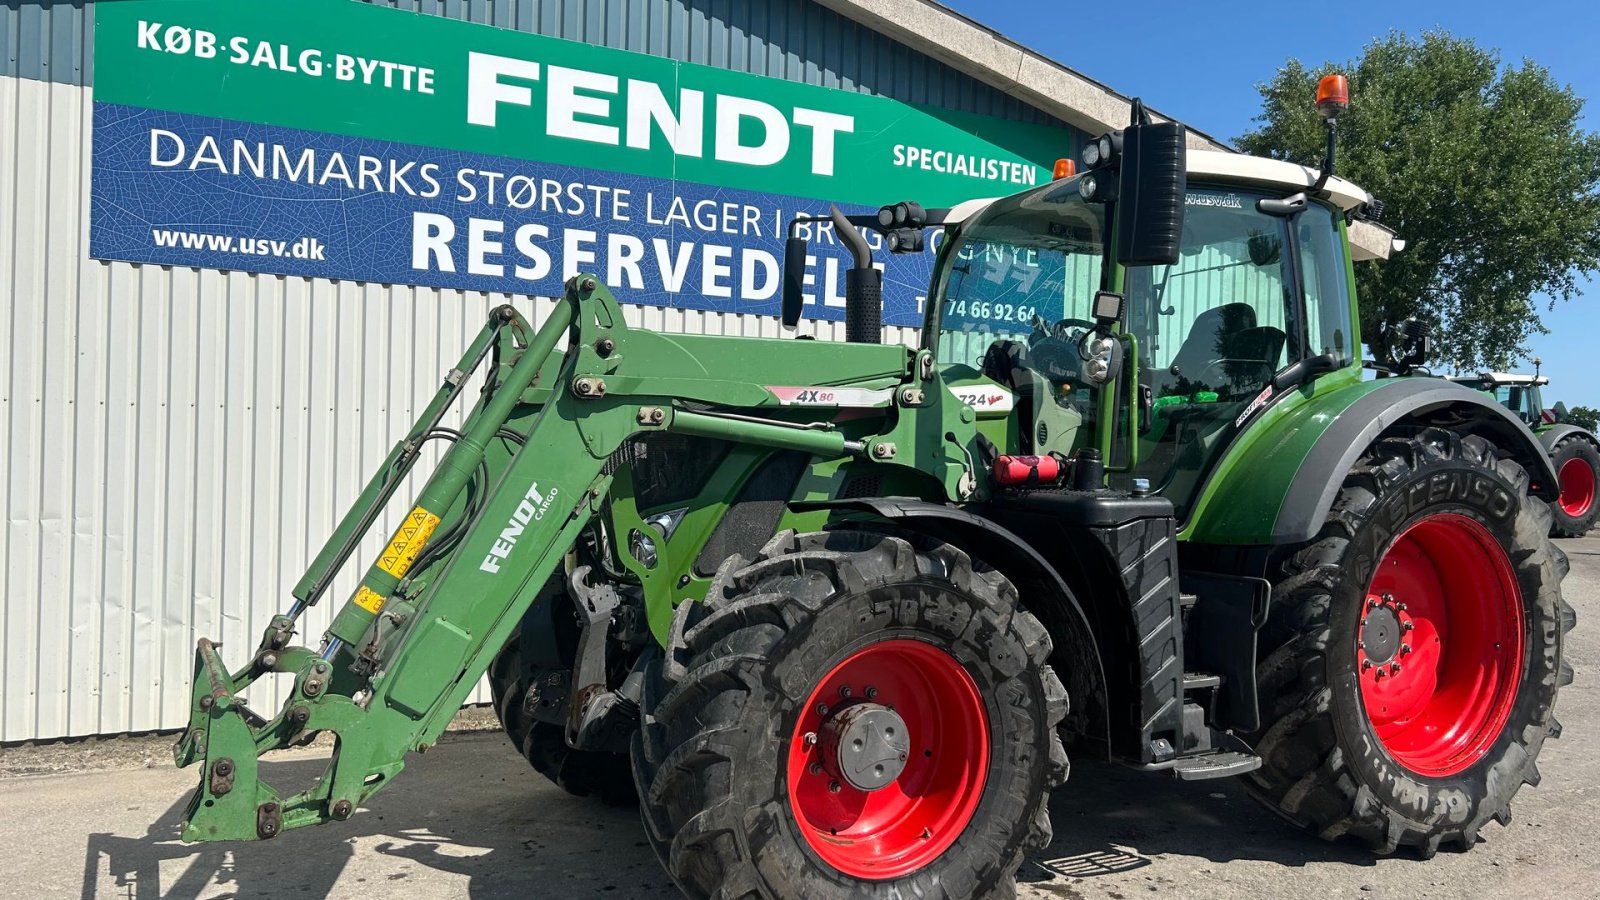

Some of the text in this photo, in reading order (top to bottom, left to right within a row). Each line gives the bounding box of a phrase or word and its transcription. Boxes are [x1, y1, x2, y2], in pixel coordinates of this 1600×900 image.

[466, 51, 856, 177] FENDT
[892, 144, 1037, 186] SPECIALISTEN
[149, 127, 442, 199] DANMARKS
[456, 167, 632, 222] STØRSTE
[645, 192, 762, 238] LAGER
[774, 209, 783, 240] I
[985, 242, 1039, 267] NYE
[152, 229, 325, 261] www.usv.dk
[411, 211, 886, 312] RESERVEDEL
[948, 300, 966, 317] 74
[971, 301, 990, 319] 66
[994, 304, 1013, 321] 92
[1017, 305, 1036, 322] 64
[959, 394, 986, 406] 724
[479, 481, 544, 574] FENDT
[534, 487, 559, 521] CARGO
[1372, 472, 1514, 554] ASCENSO
